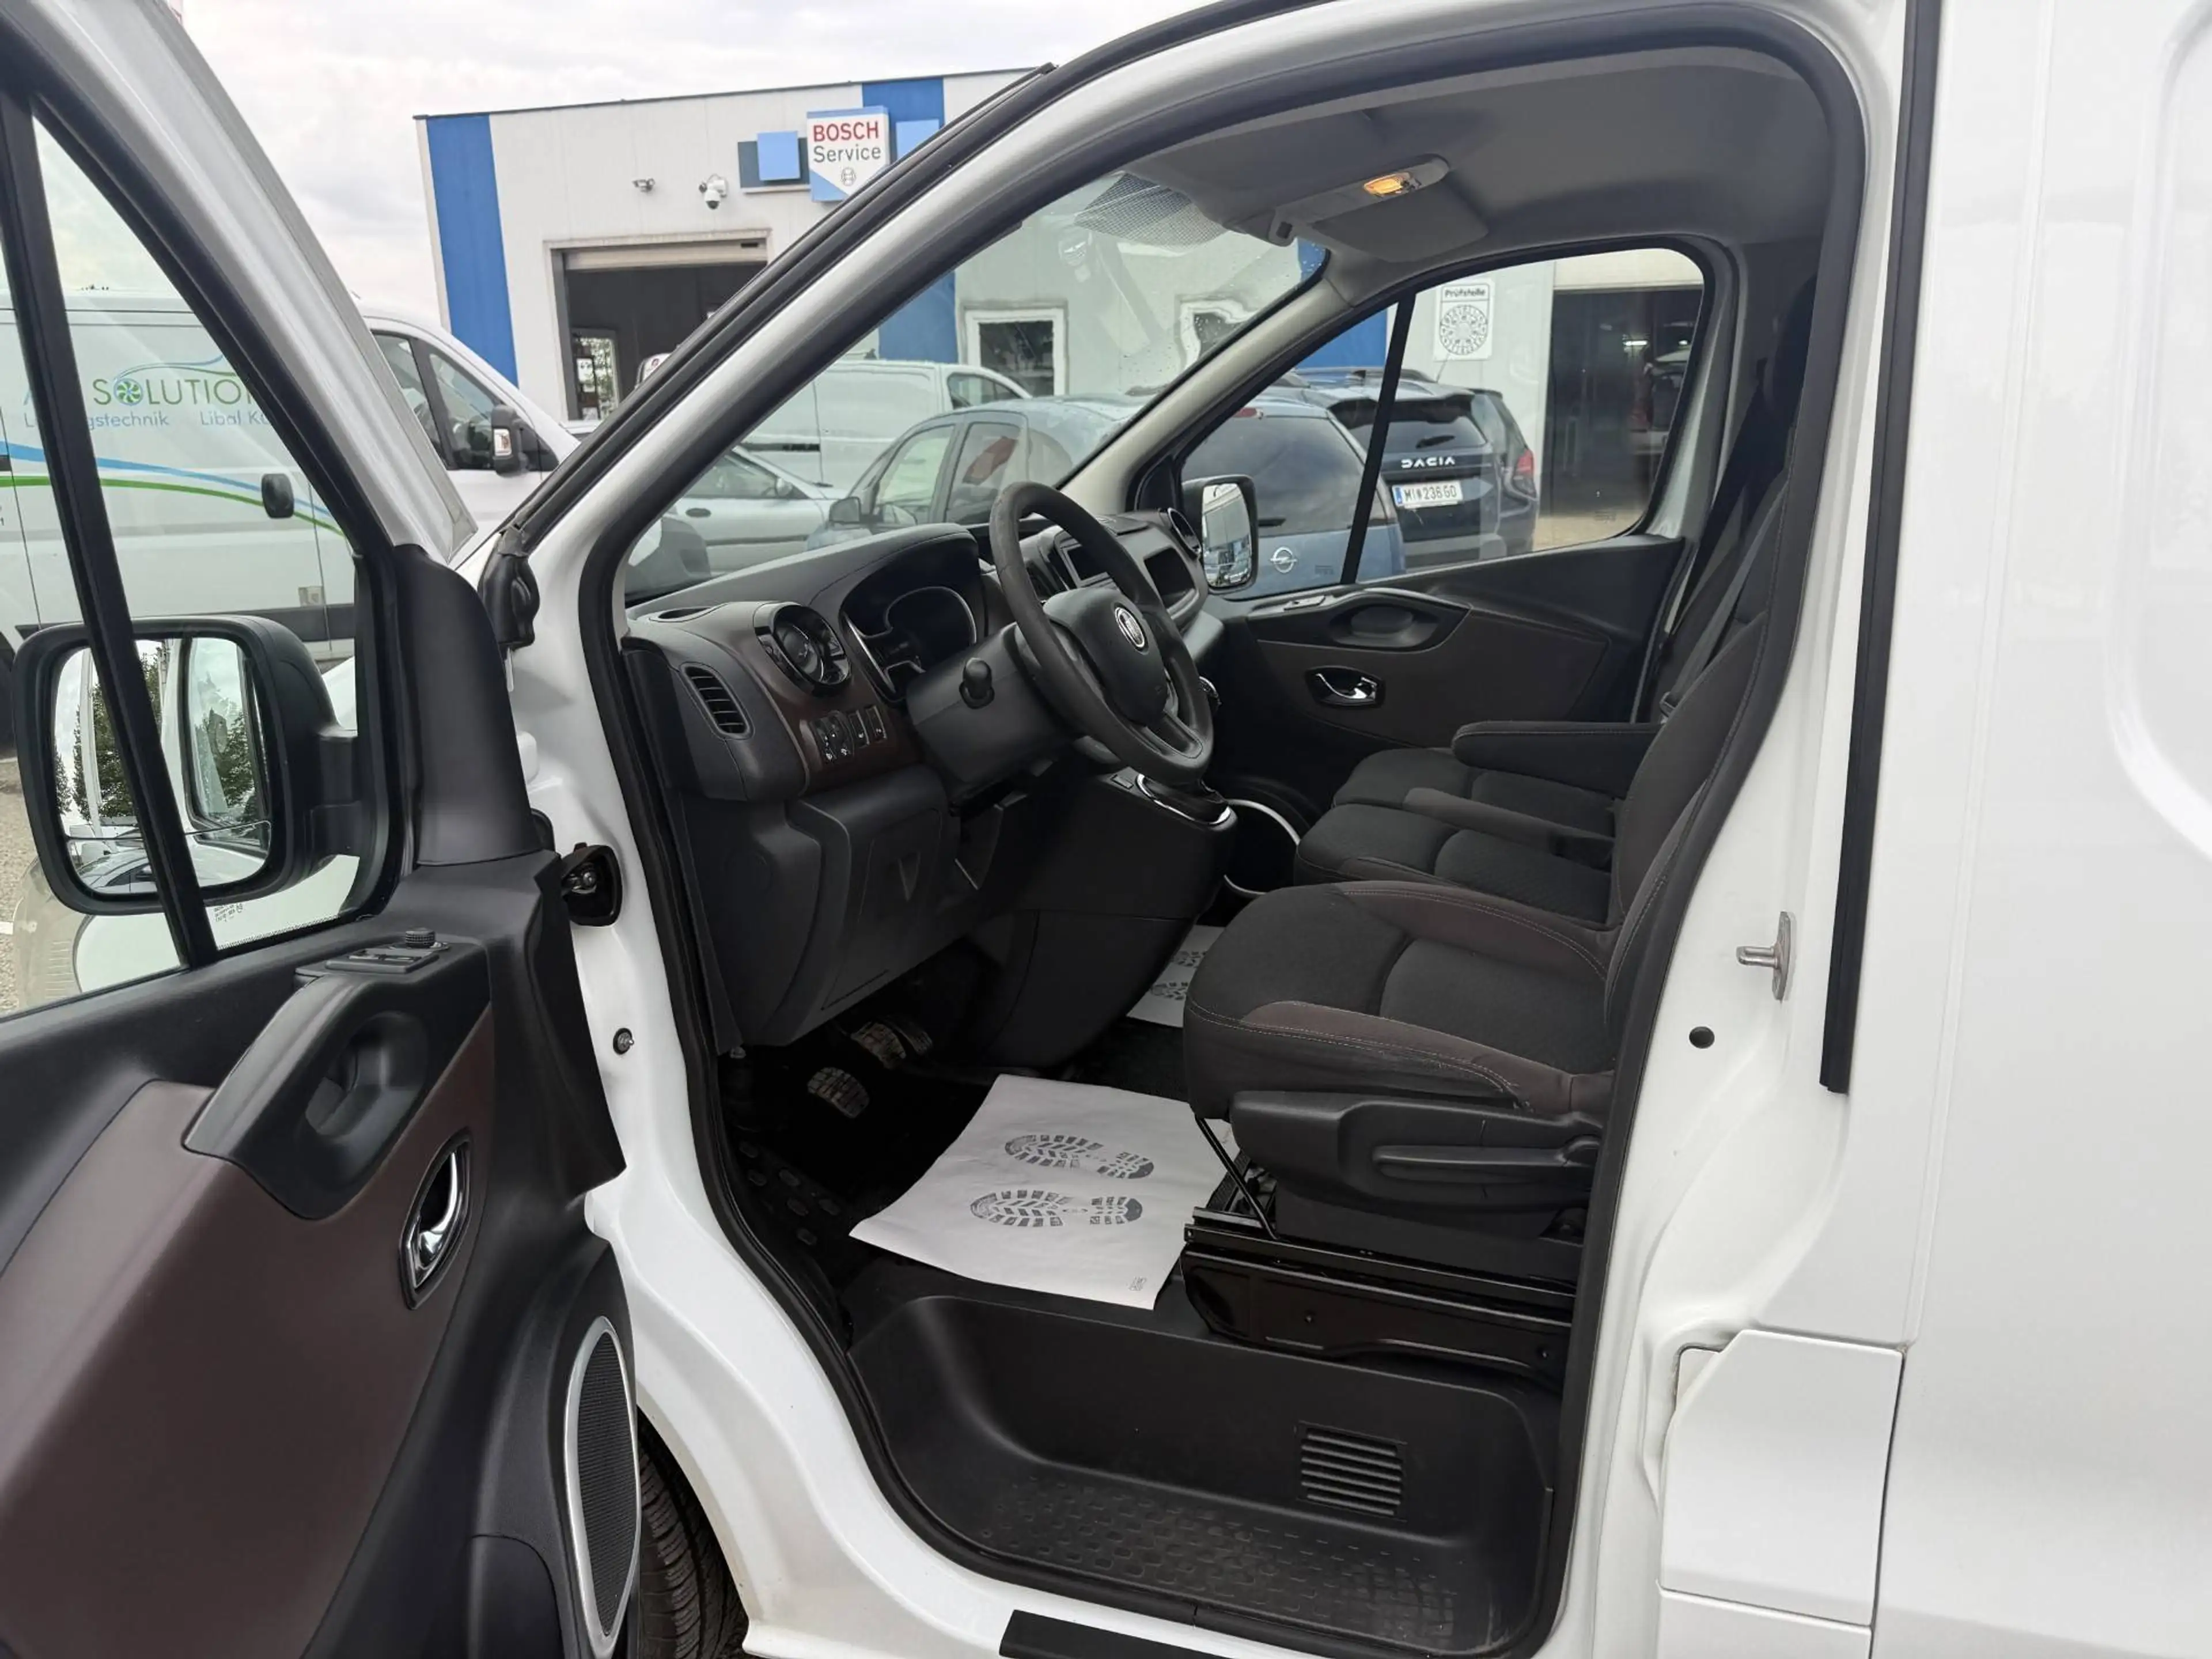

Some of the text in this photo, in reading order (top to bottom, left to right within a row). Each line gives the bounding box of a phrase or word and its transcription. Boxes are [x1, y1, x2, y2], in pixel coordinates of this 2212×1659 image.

[813, 121, 879, 142] BOSCH
[813, 143, 881, 163] Service
[200, 410, 243, 426] Libal
[1400, 456, 1456, 469] DACIA
